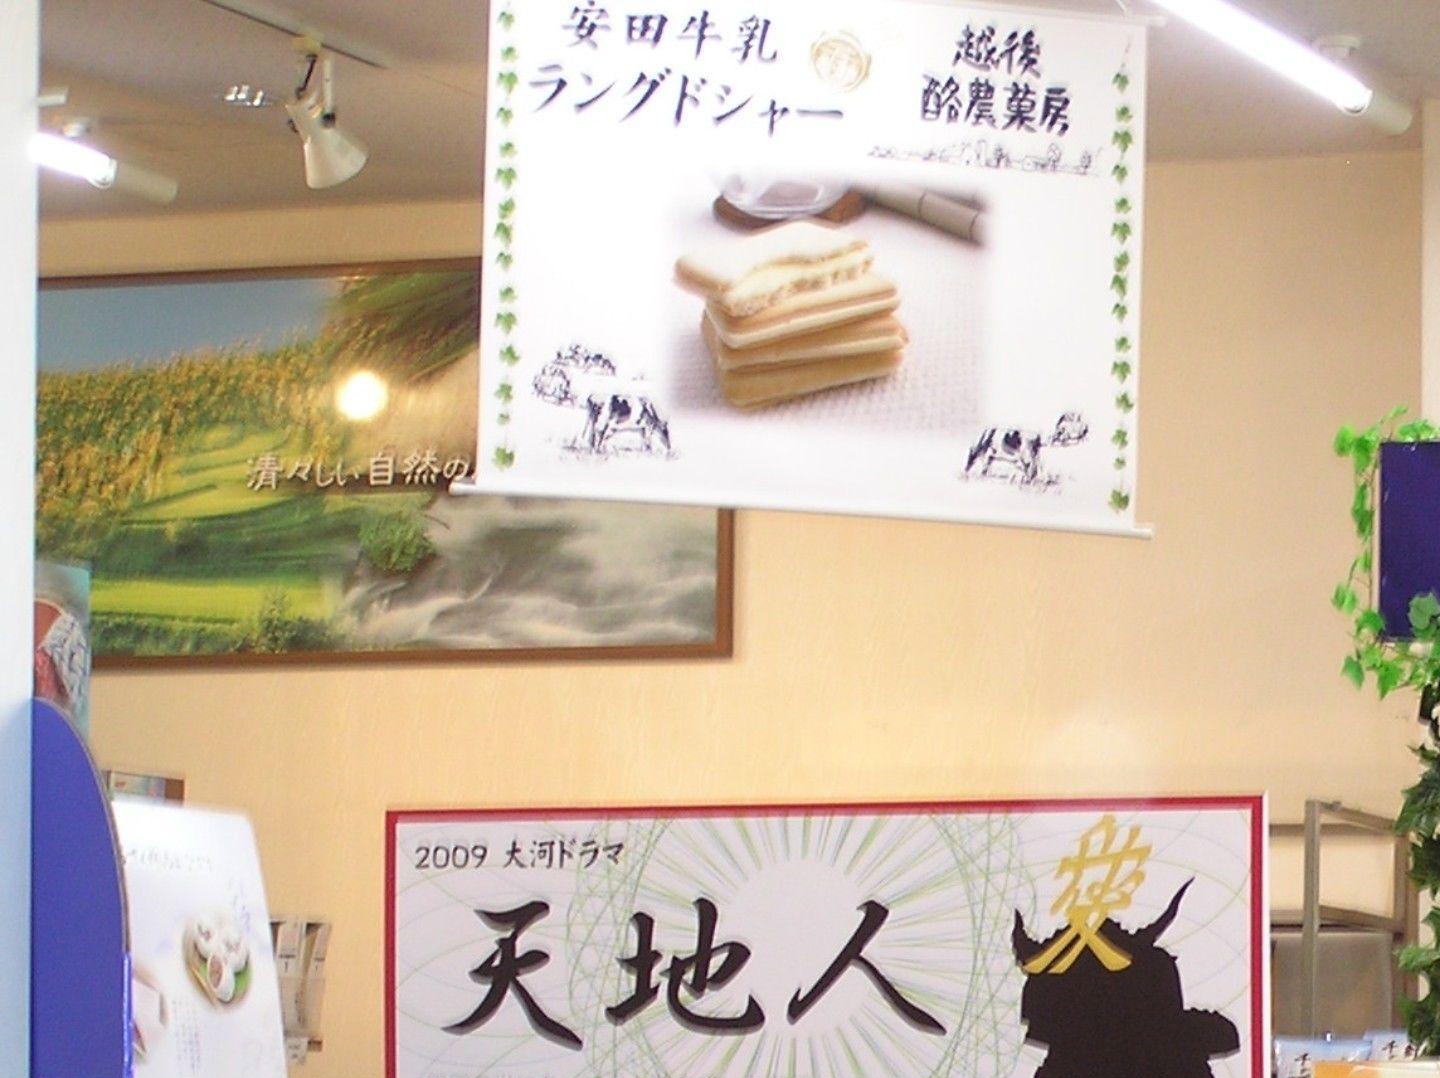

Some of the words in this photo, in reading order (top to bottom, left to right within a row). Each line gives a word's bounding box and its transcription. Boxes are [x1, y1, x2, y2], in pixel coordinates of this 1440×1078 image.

[562, 0, 778, 64] 安田牛乳
[952, 24, 1041, 78] 越後
[529, 64, 843, 137] ラングドシャー
[921, 74, 1070, 137] 酪農菓房
[415, 845, 489, 870] 2009
[503, 838, 625, 870] 大河ドラマ
[443, 898, 948, 1052] 天地人
